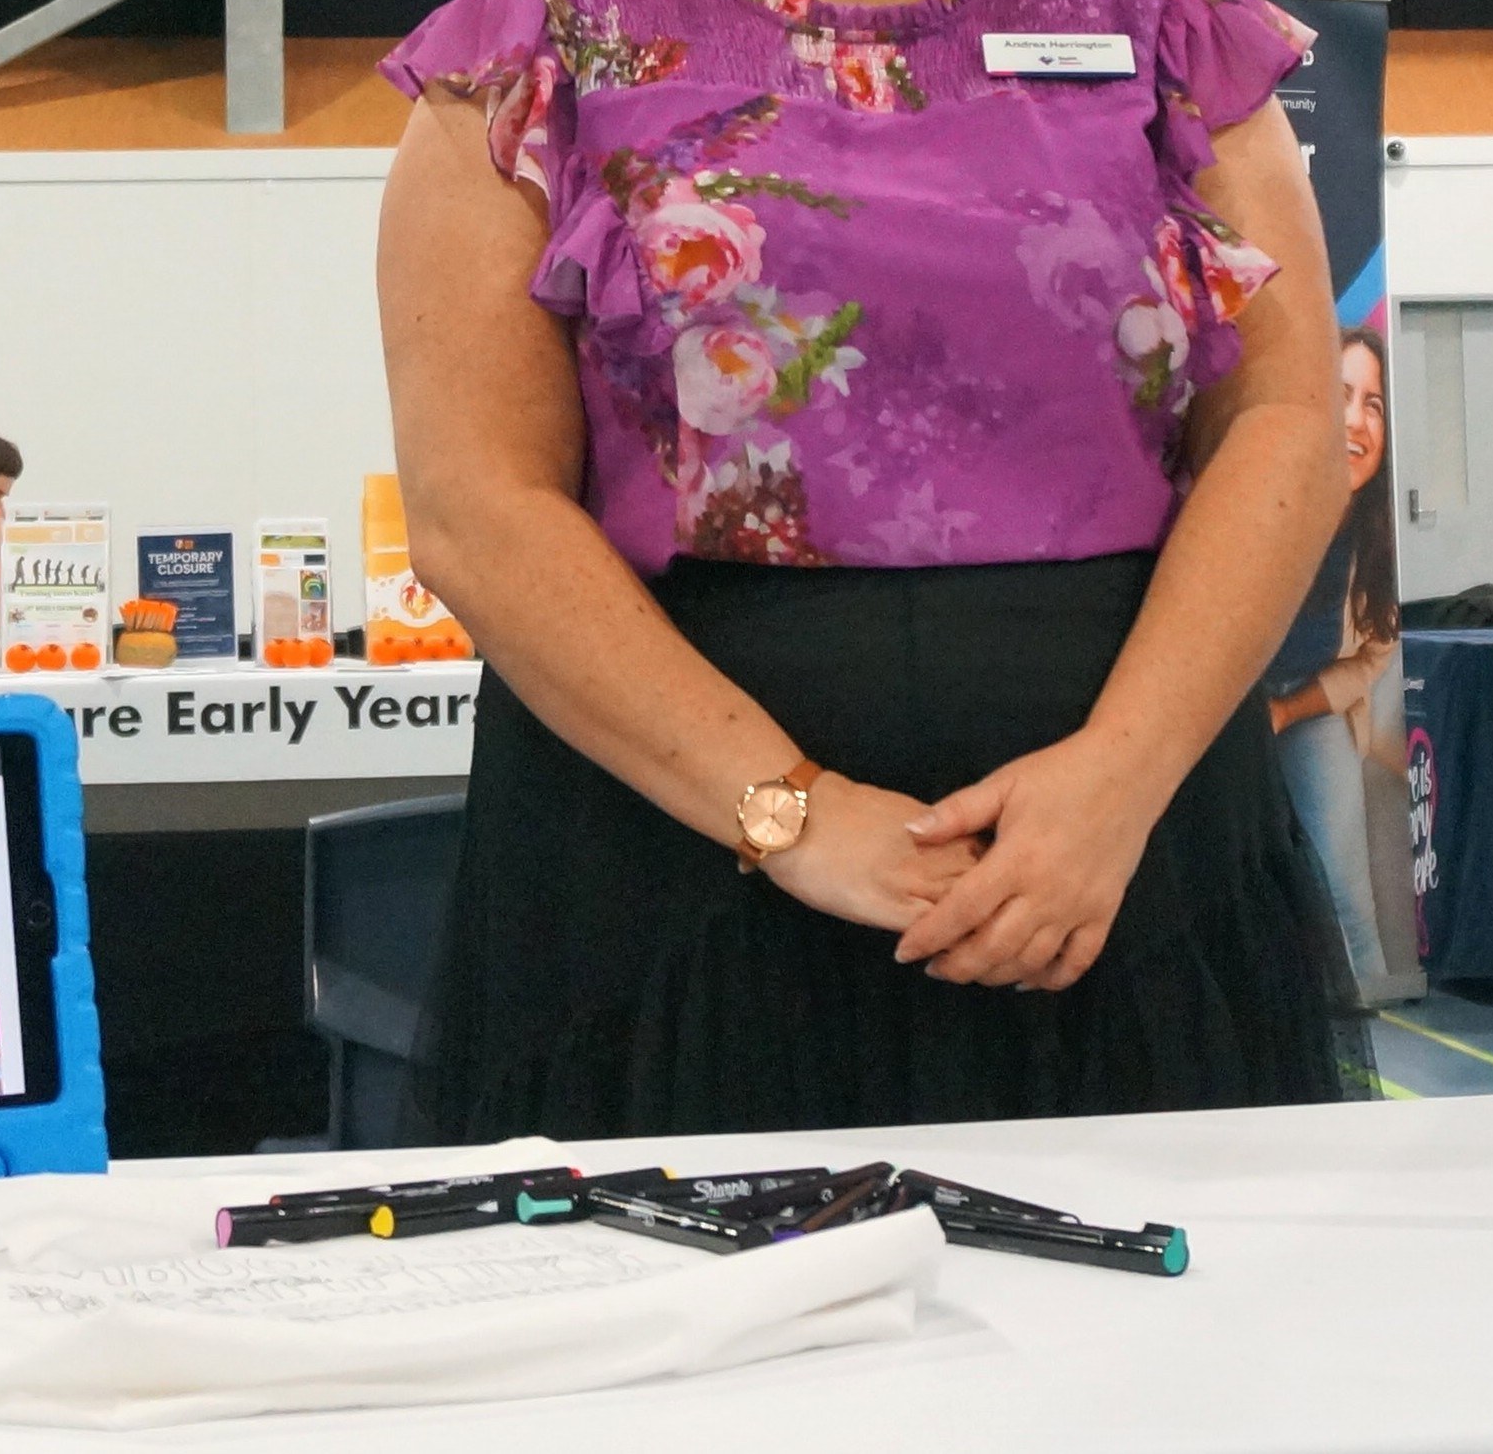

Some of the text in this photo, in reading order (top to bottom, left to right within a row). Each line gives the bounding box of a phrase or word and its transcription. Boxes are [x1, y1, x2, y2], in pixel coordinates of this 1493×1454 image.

[148, 551, 223, 564] TEMPORARY
[157, 563, 214, 575] CLOSURE
[167, 686, 318, 745] Early
[693, 1179, 753, 1202] Sharpie
